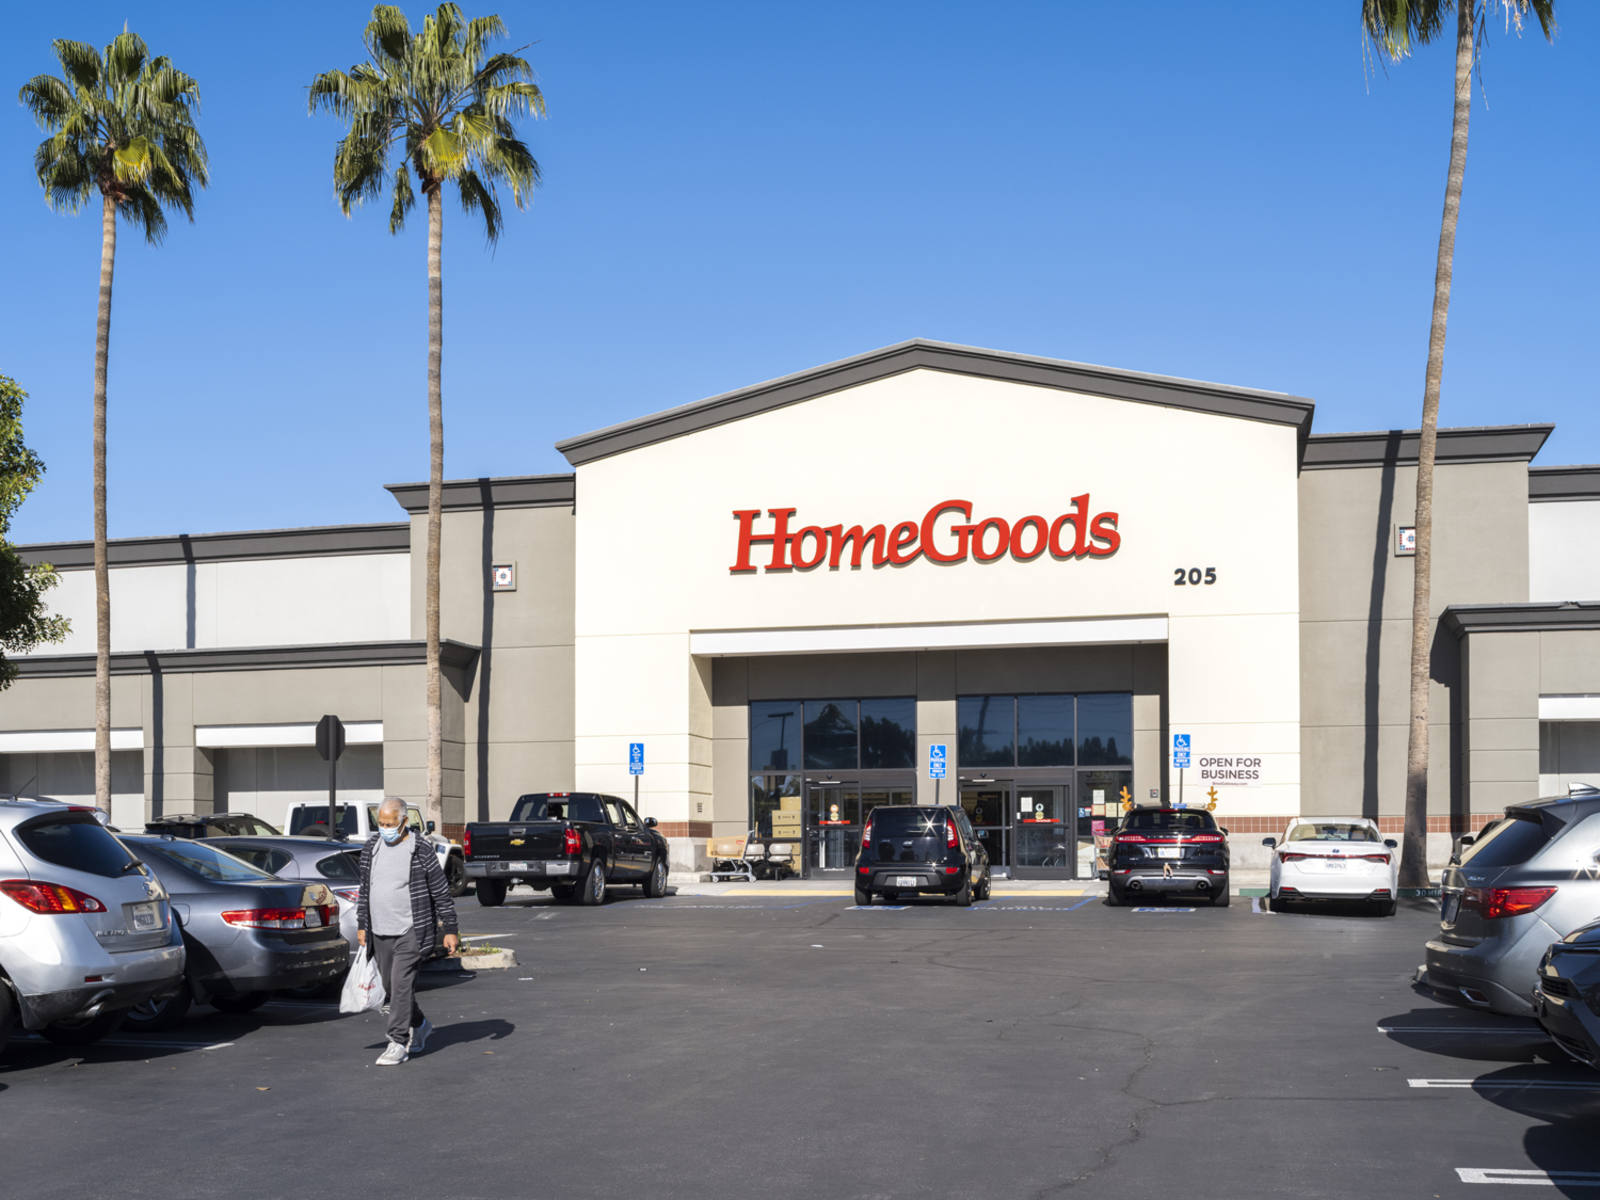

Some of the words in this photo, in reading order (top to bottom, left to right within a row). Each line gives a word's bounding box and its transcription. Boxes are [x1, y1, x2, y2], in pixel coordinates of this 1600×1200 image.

[728, 493, 1121, 571] HomeGoods
[1174, 567, 1217, 586] 205
[1200, 757, 1233, 767] OPEN
[1236, 757, 1261, 767] FOR
[1201, 769, 1259, 779] BUSINESS
